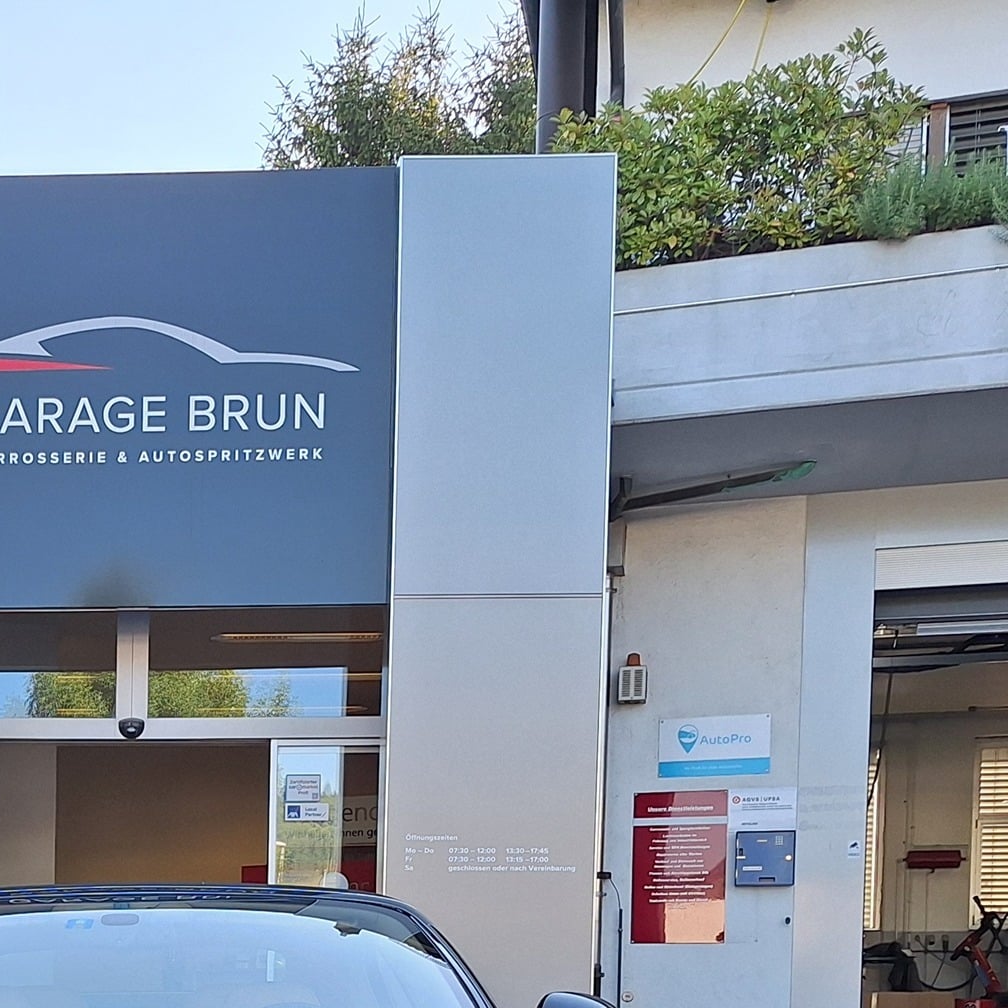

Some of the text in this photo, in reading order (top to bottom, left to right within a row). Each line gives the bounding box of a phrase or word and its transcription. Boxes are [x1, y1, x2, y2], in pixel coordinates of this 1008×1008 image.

[188, 393, 325, 431] BRUN
[117, 451, 128, 463] &
[138, 448, 323, 463] AUTOSPRITZWERK
[699, 733, 752, 745] AutoPro
[405, 833, 458, 842] Öffnungszeiten
[448, 865, 491, 873] geschlossen
